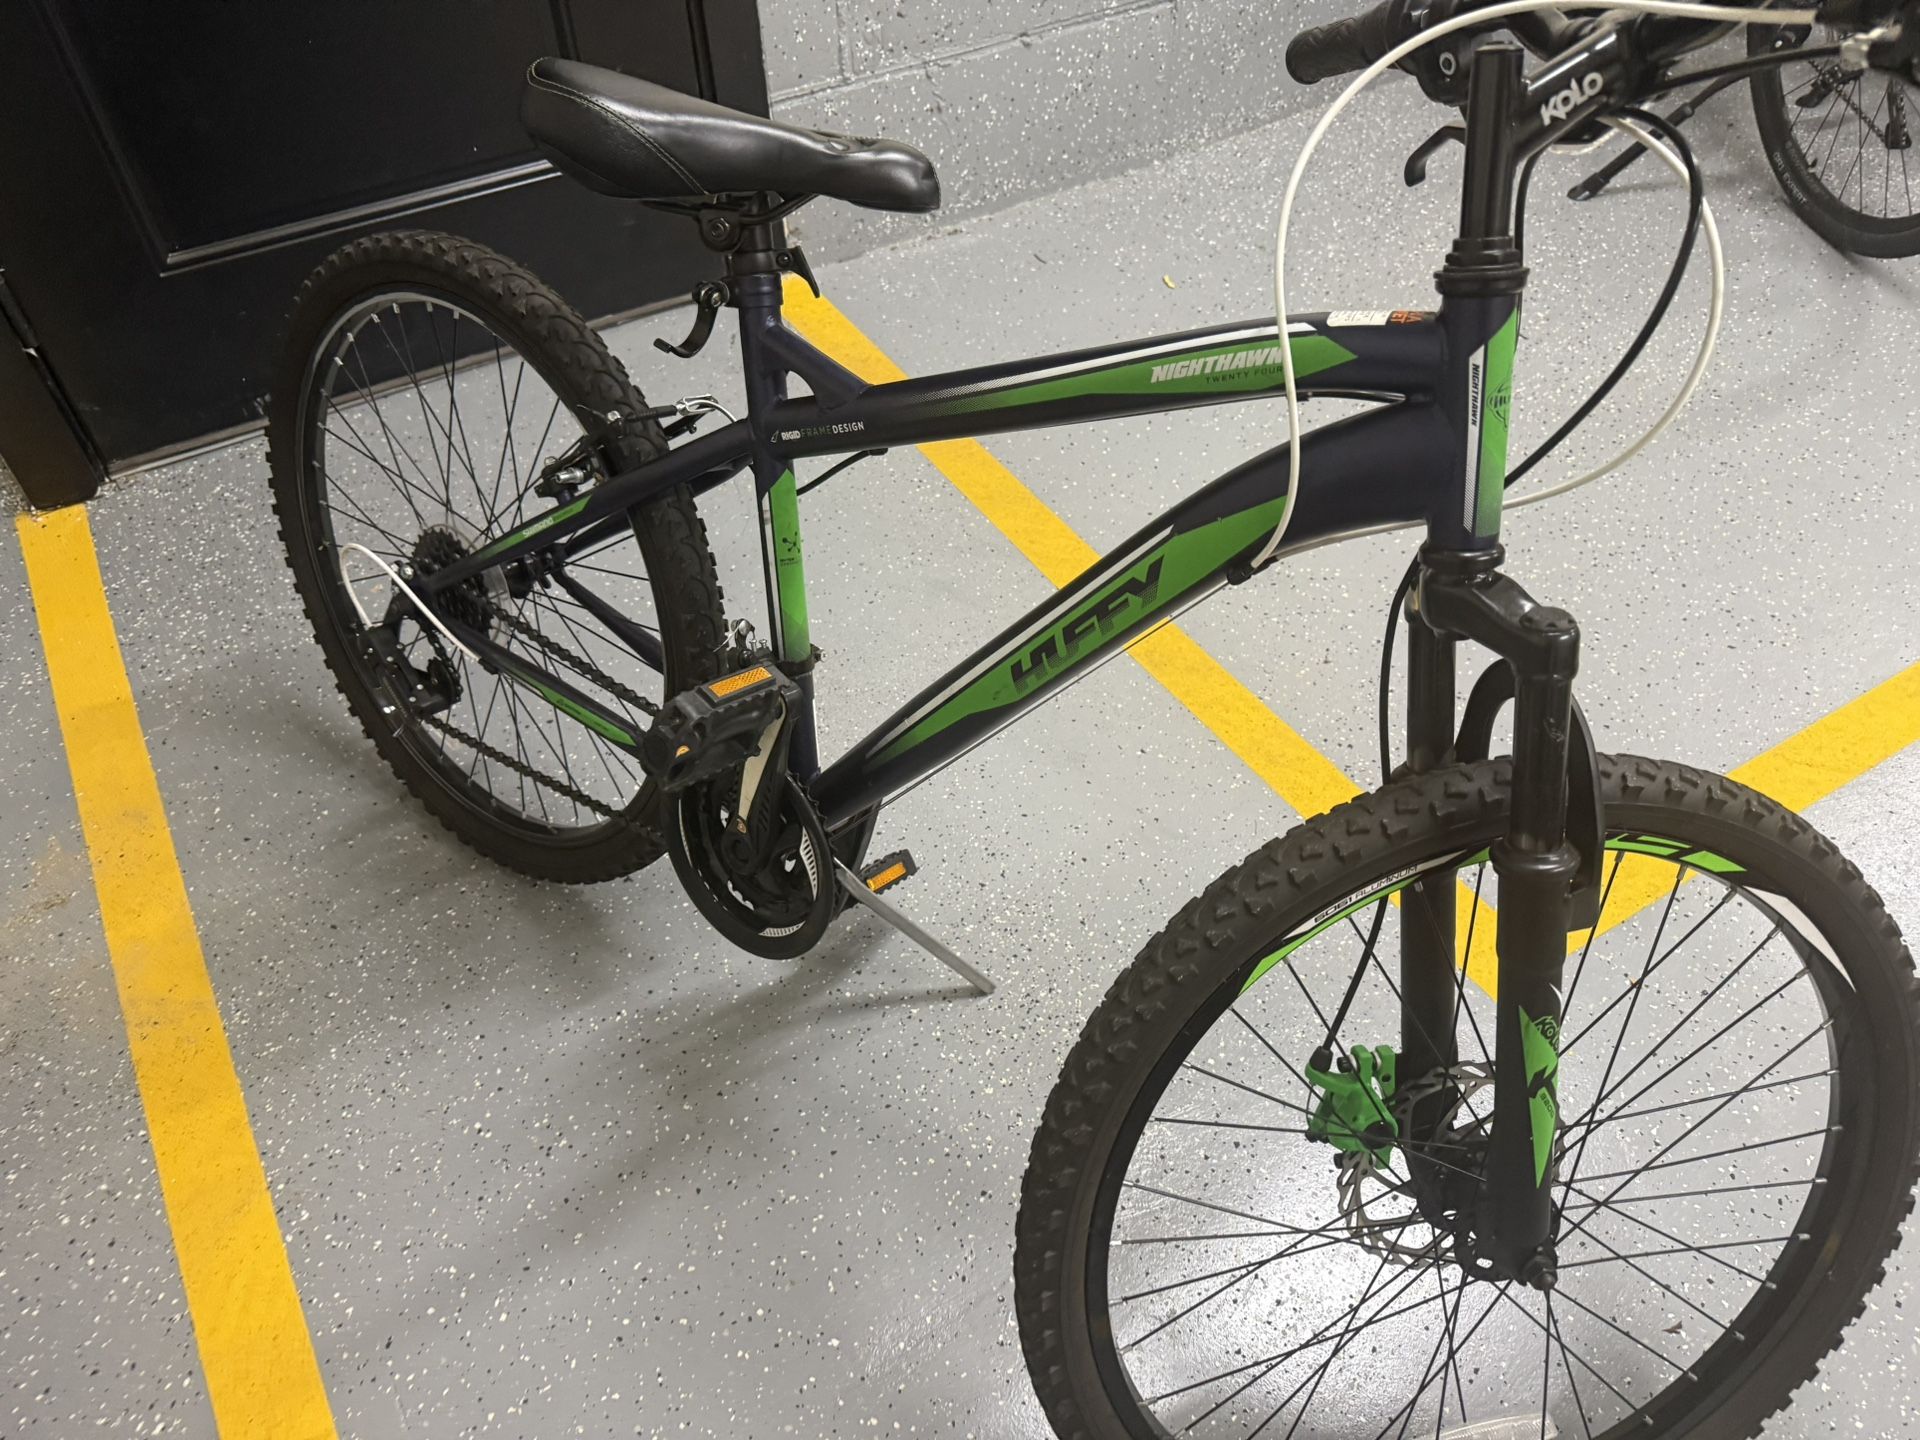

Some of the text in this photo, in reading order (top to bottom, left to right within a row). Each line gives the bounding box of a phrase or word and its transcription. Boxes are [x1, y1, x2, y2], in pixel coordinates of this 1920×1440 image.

[1540, 72, 1603, 126] KOLO
[1205, 365, 1283, 384] TWENTY FOUR
[1471, 363, 1480, 427] NIGHTHAWK
[1011, 554, 1165, 694] HUFFY
[1314, 864, 1418, 923] 6061 ALUMINUM
